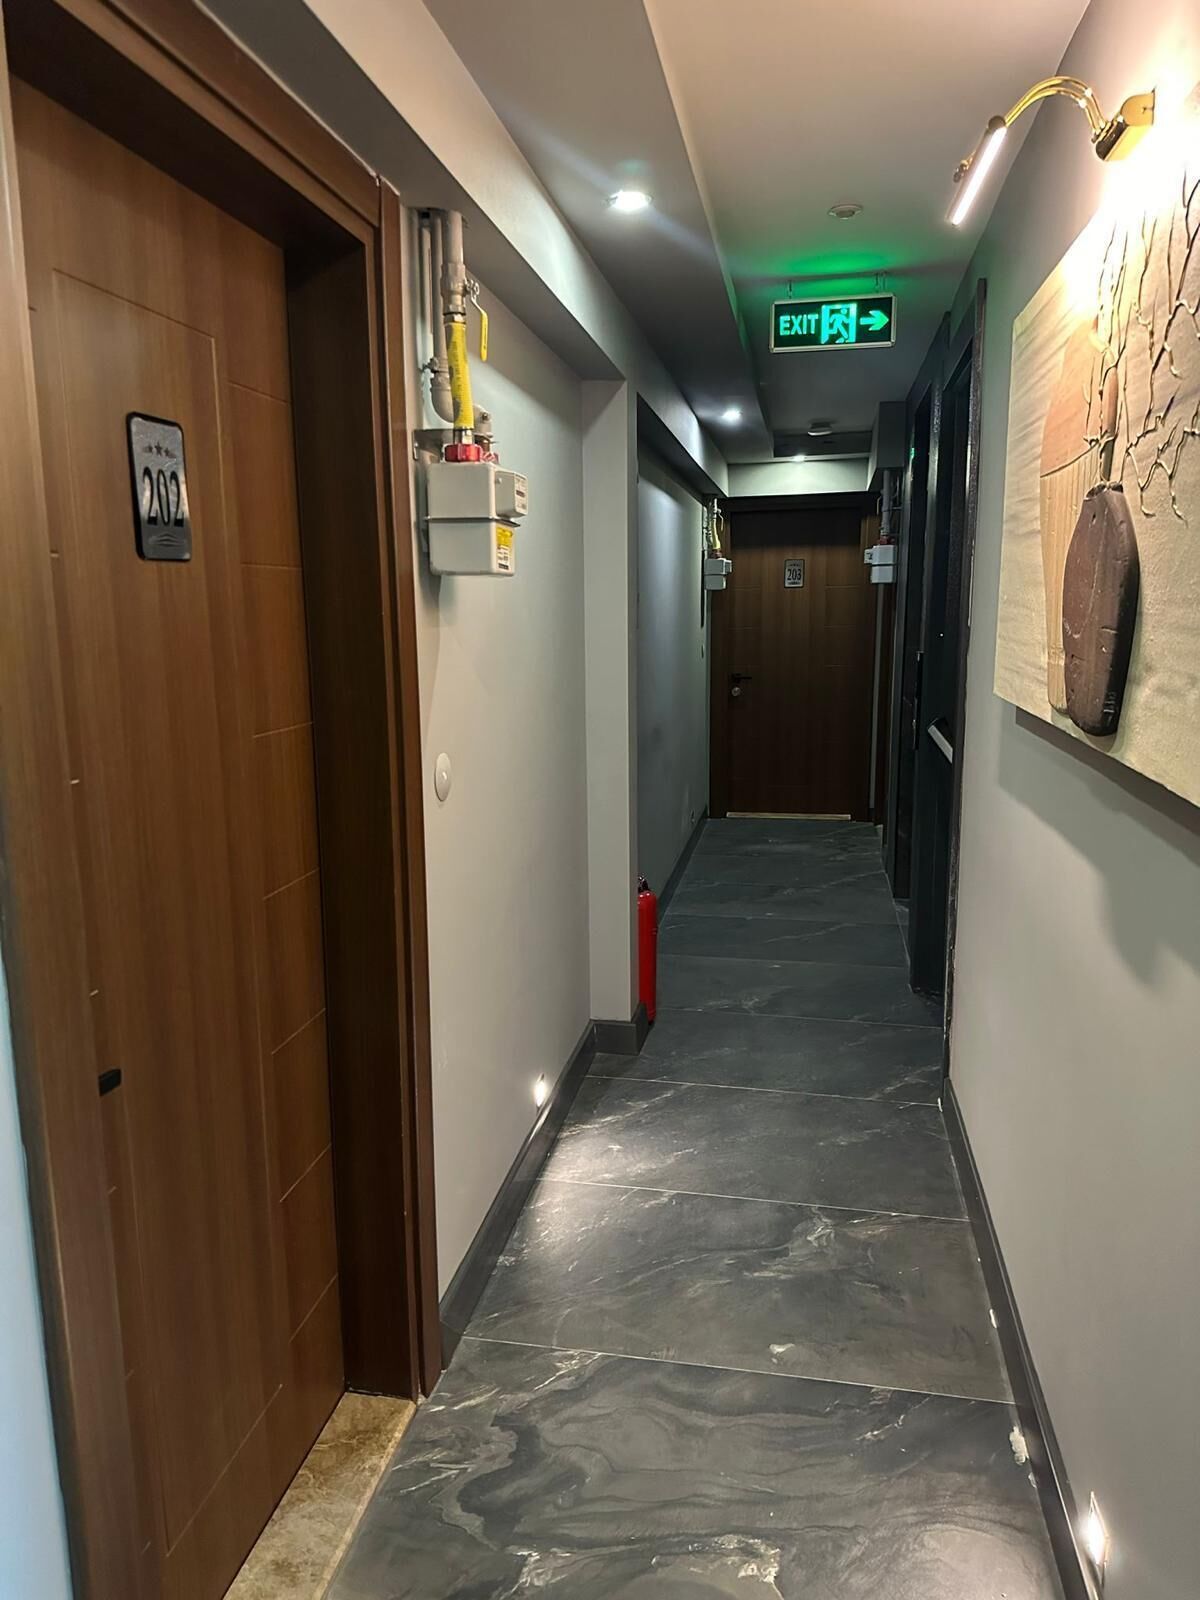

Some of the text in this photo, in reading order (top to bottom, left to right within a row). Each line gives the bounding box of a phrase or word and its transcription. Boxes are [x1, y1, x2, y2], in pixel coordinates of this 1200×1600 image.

[779, 313, 819, 336] EXIT
[142, 466, 185, 527] 202
[787, 568, 802, 581] 203
